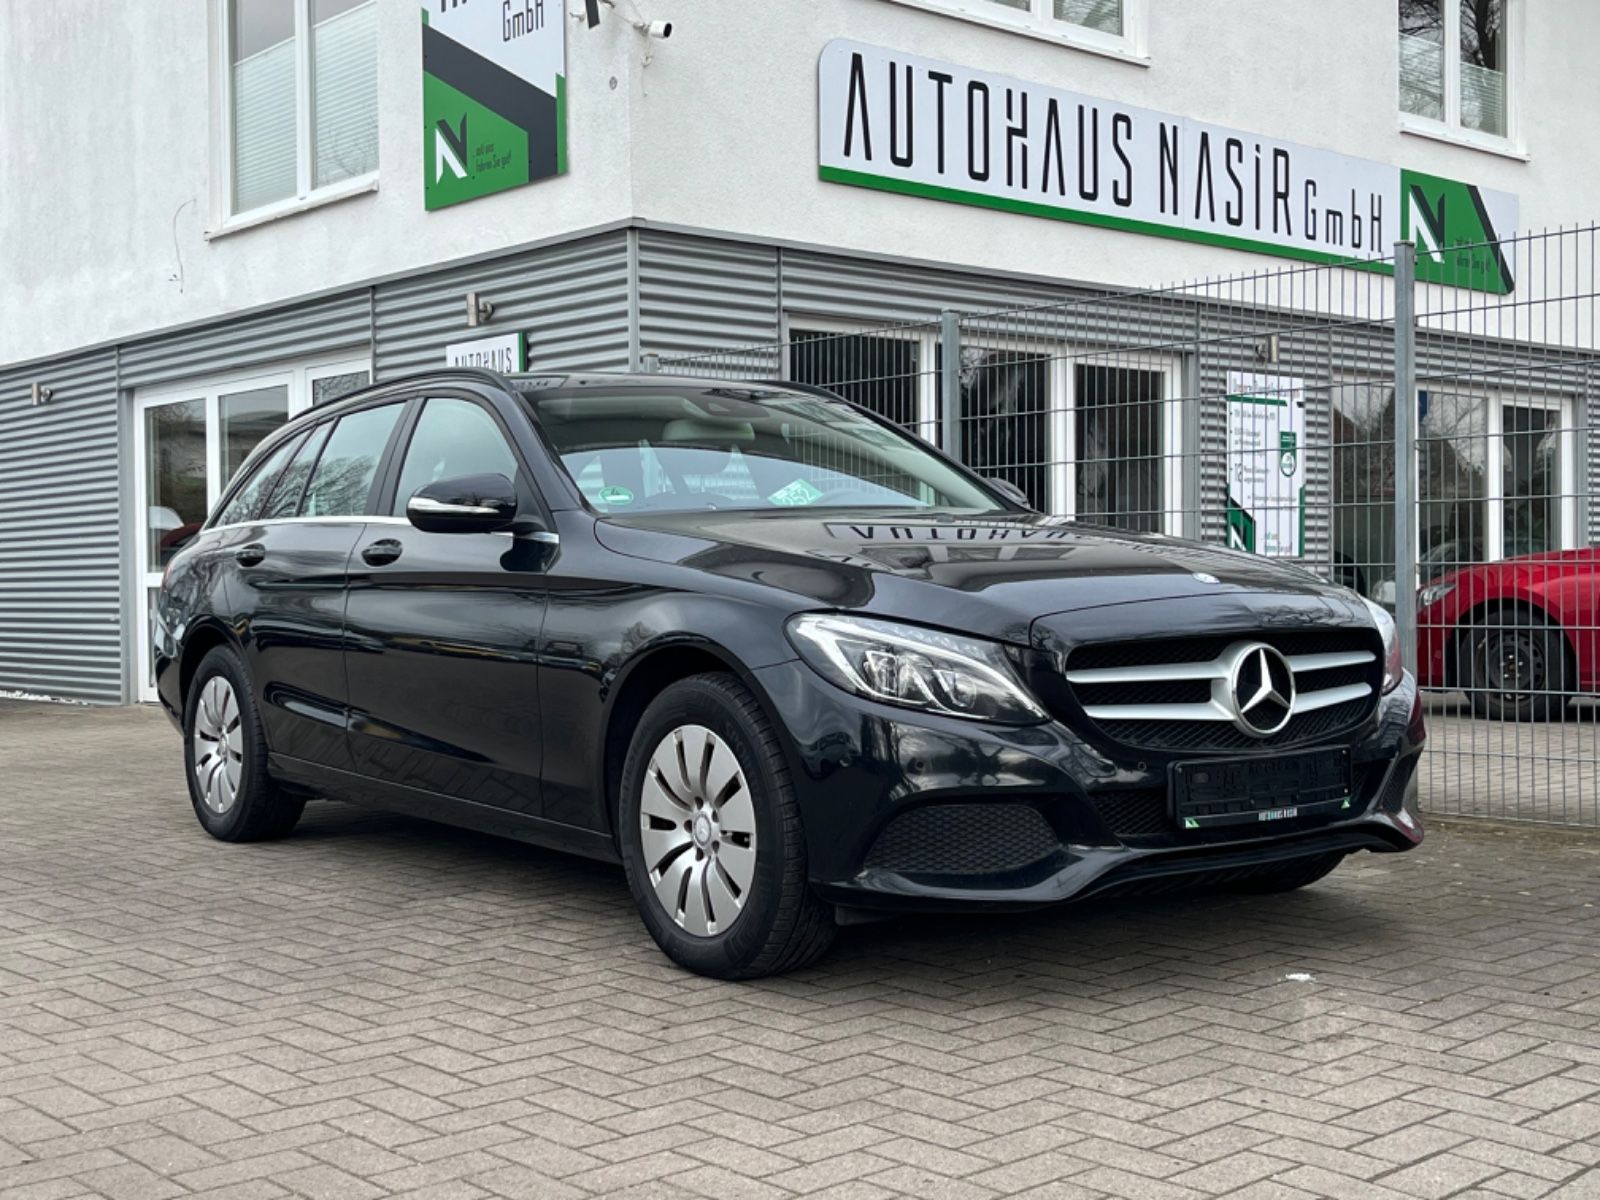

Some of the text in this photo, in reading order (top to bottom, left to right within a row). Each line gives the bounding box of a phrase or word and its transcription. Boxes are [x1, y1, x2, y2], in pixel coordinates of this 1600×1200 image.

[502, 0, 544, 42] GmbH
[843, 52, 1133, 207] AUTOHAUS
[1305, 179, 1382, 253] GmbH
